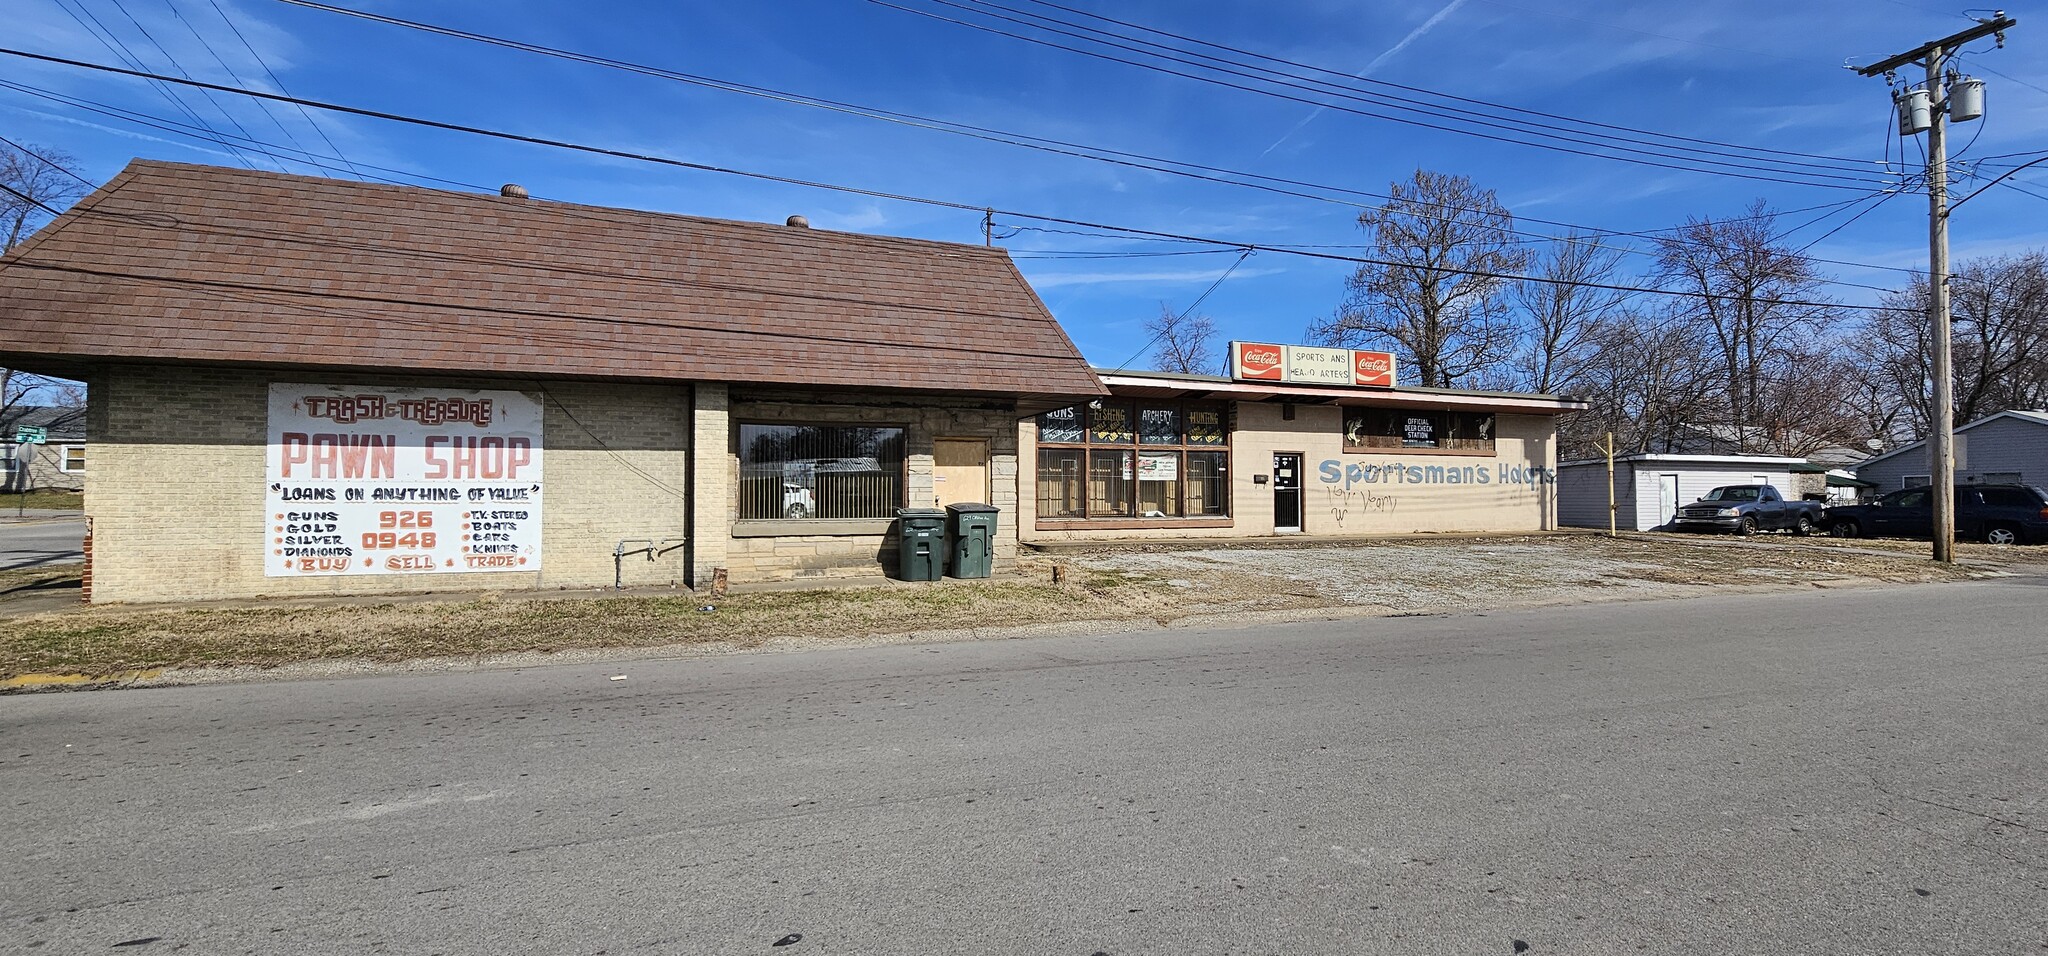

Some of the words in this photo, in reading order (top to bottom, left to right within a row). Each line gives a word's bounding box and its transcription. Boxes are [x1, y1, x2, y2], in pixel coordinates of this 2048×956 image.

[1245, 351, 1279, 364] Coca-Cola
[1296, 352, 1325, 362] SPORTS
[1359, 358, 1389, 371] Coca-Cola
[305, 395, 385, 422] TRASH
[398, 397, 492, 427] TREASURE
[1142, 410, 1173, 423] ARCHERY
[281, 432, 396, 479] PAWN
[424, 435, 531, 479] SHOP
[1319, 459, 1491, 490] Sportsman's
[344, 488, 365, 501] ON
[371, 488, 461, 501] ANYTHING
[467, 487, 486, 501] OF
[287, 512, 339, 521] GUNS
[379, 511, 433, 528] 926
[286, 524, 338, 533] GOLD
[471, 522, 518, 531] BOATS
[285, 535, 344, 545] SILVER
[361, 532, 437, 549] 0948
[472, 533, 510, 542] CARS
[283, 547, 354, 557] DIAMONDS
[472, 544, 519, 554] KNIVES
[300, 557, 348, 571] BUY
[387, 556, 435, 571] SELL
[466, 555, 516, 567] TRADE
